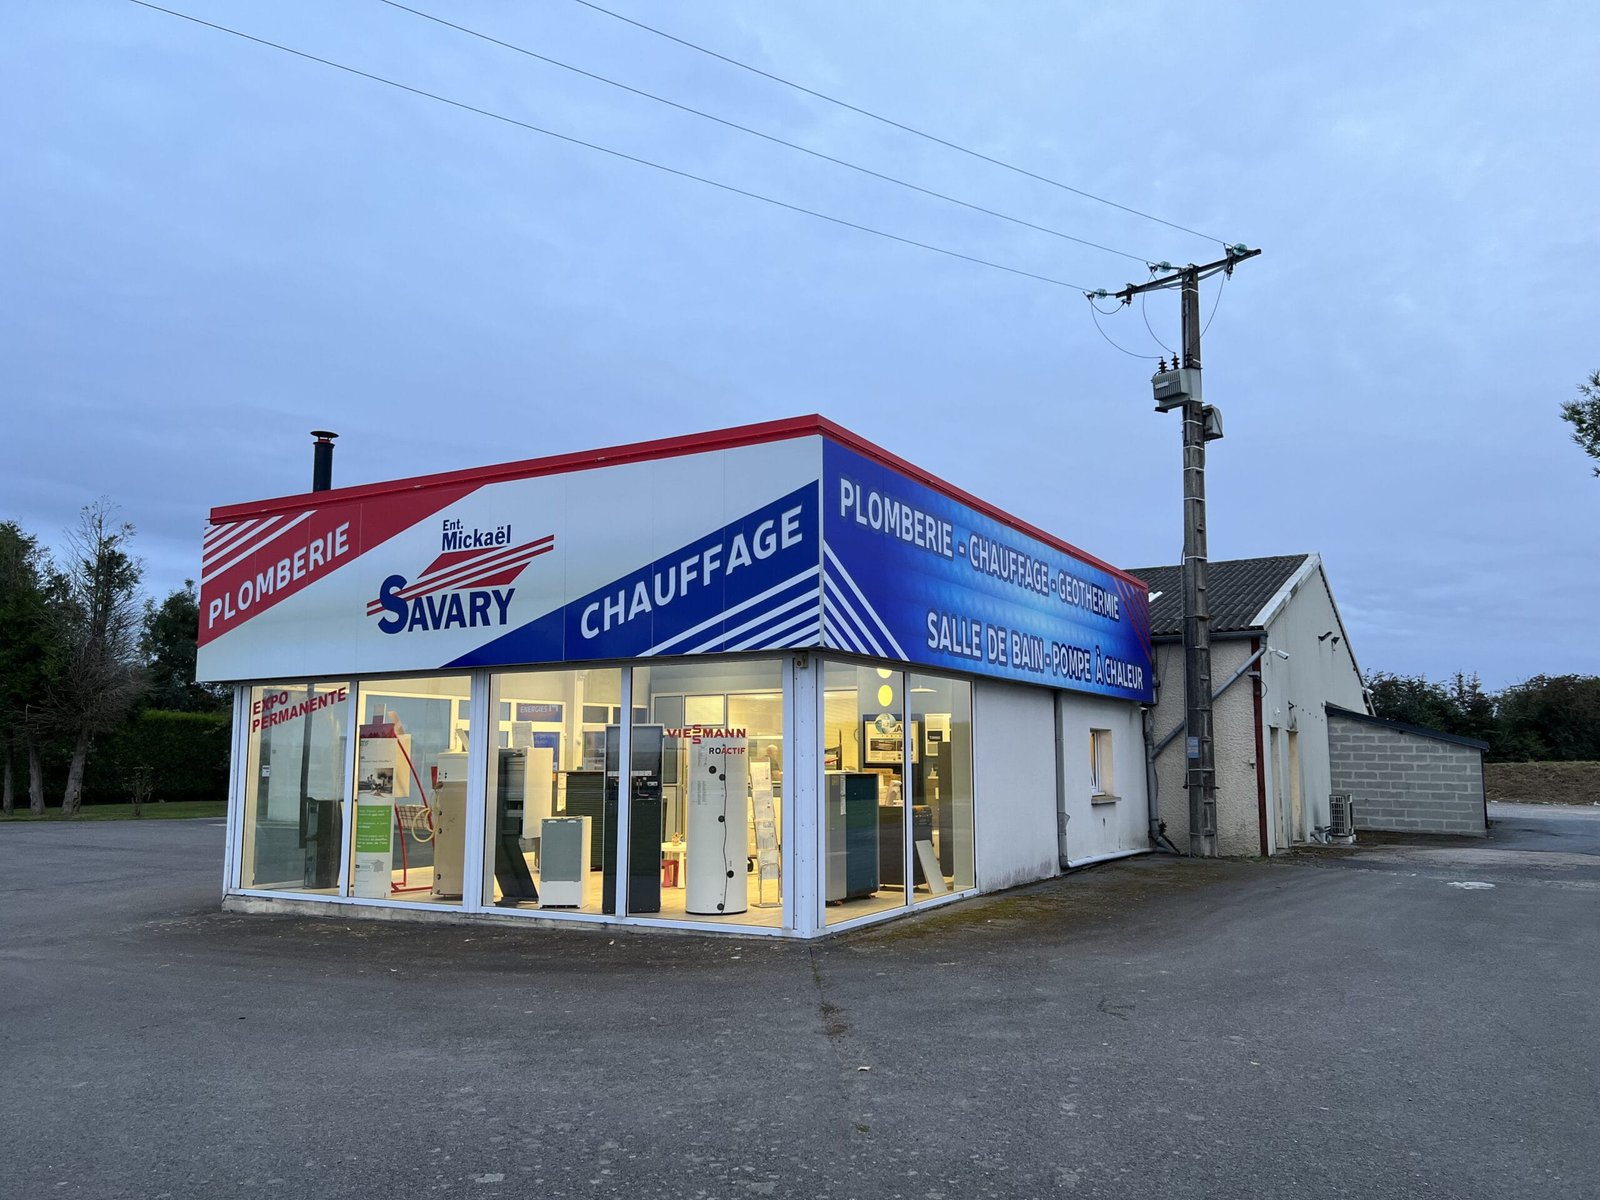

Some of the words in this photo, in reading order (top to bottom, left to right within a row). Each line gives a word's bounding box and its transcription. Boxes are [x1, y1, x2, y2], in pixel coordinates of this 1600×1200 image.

[441, 525, 512, 552] Mickaël
[442, 519, 464, 532] Ent.
[840, 478, 953, 558] PLOMBERIE
[970, 535, 1048, 594] CHAUFFAGE
[1058, 572, 1119, 620] GEOTHERMIE
[208, 520, 351, 629] PLOMBERIE
[580, 504, 803, 639] CHAUFFAGE
[377, 574, 516, 635] SAVARY
[927, 611, 983, 657] SALLE
[987, 626, 1008, 663] DE
[1104, 658, 1143, 690] CHALEUR
[252, 690, 289, 716] EXPO
[252, 687, 347, 733] PERMANENTE
[666, 724, 747, 745] VIESSMANN
